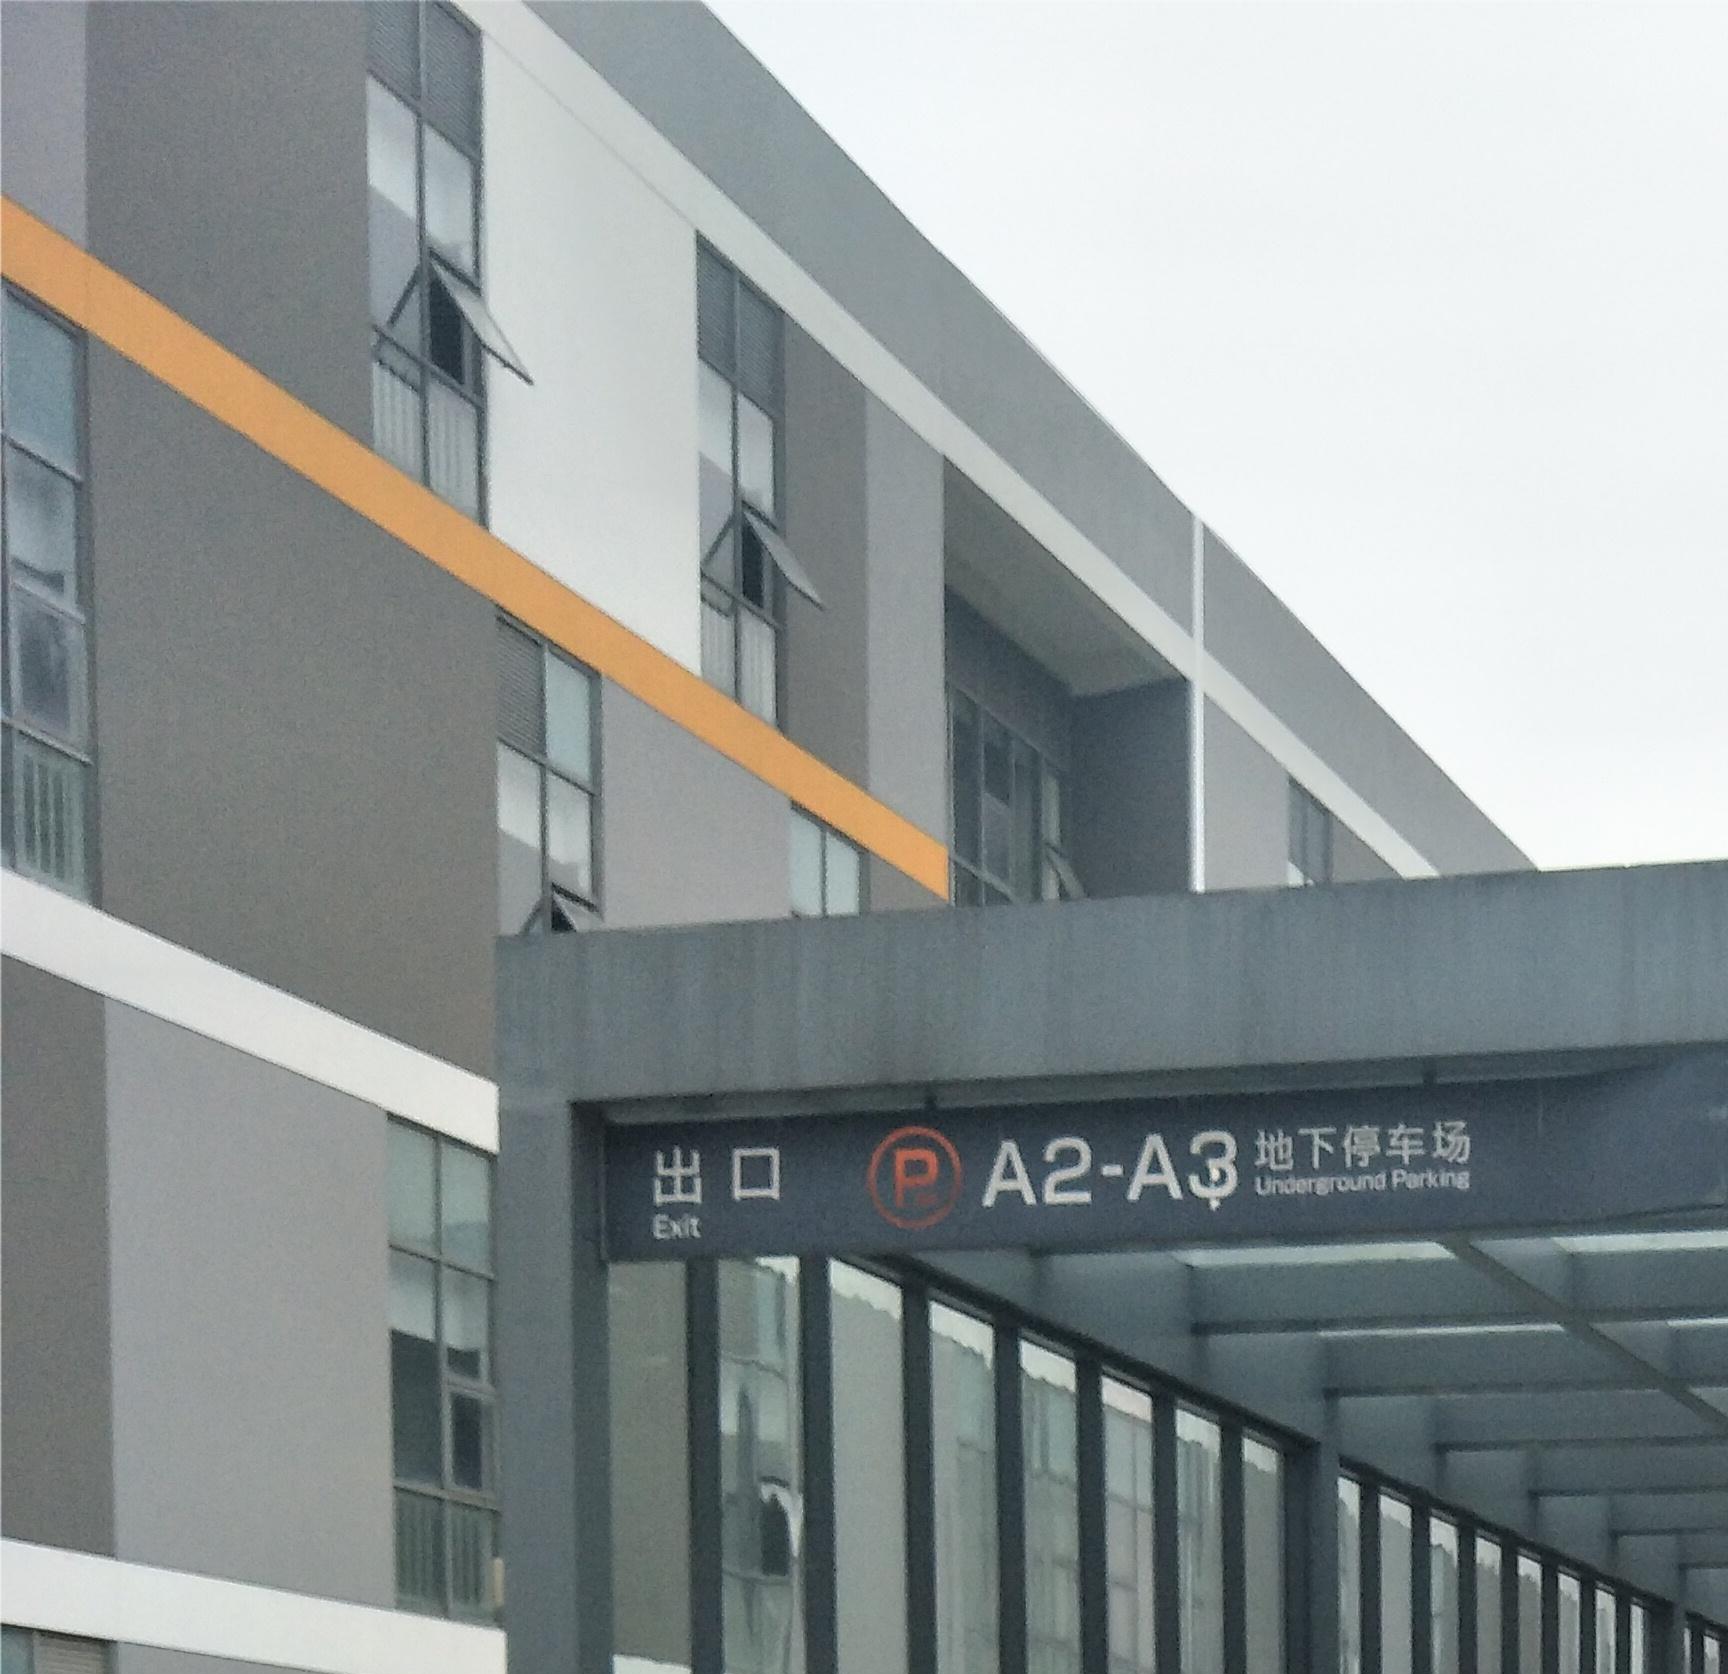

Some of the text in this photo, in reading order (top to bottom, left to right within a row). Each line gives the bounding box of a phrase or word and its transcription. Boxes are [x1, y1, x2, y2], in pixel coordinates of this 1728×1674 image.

[982, 1130, 1239, 1208] A2-A3
[1255, 1120, 1472, 1171] 地下停车场
[653, 1146, 781, 1206] 出口
[1255, 1168, 1472, 1198] Underground Parking
[653, 1214, 702, 1240] Exit
